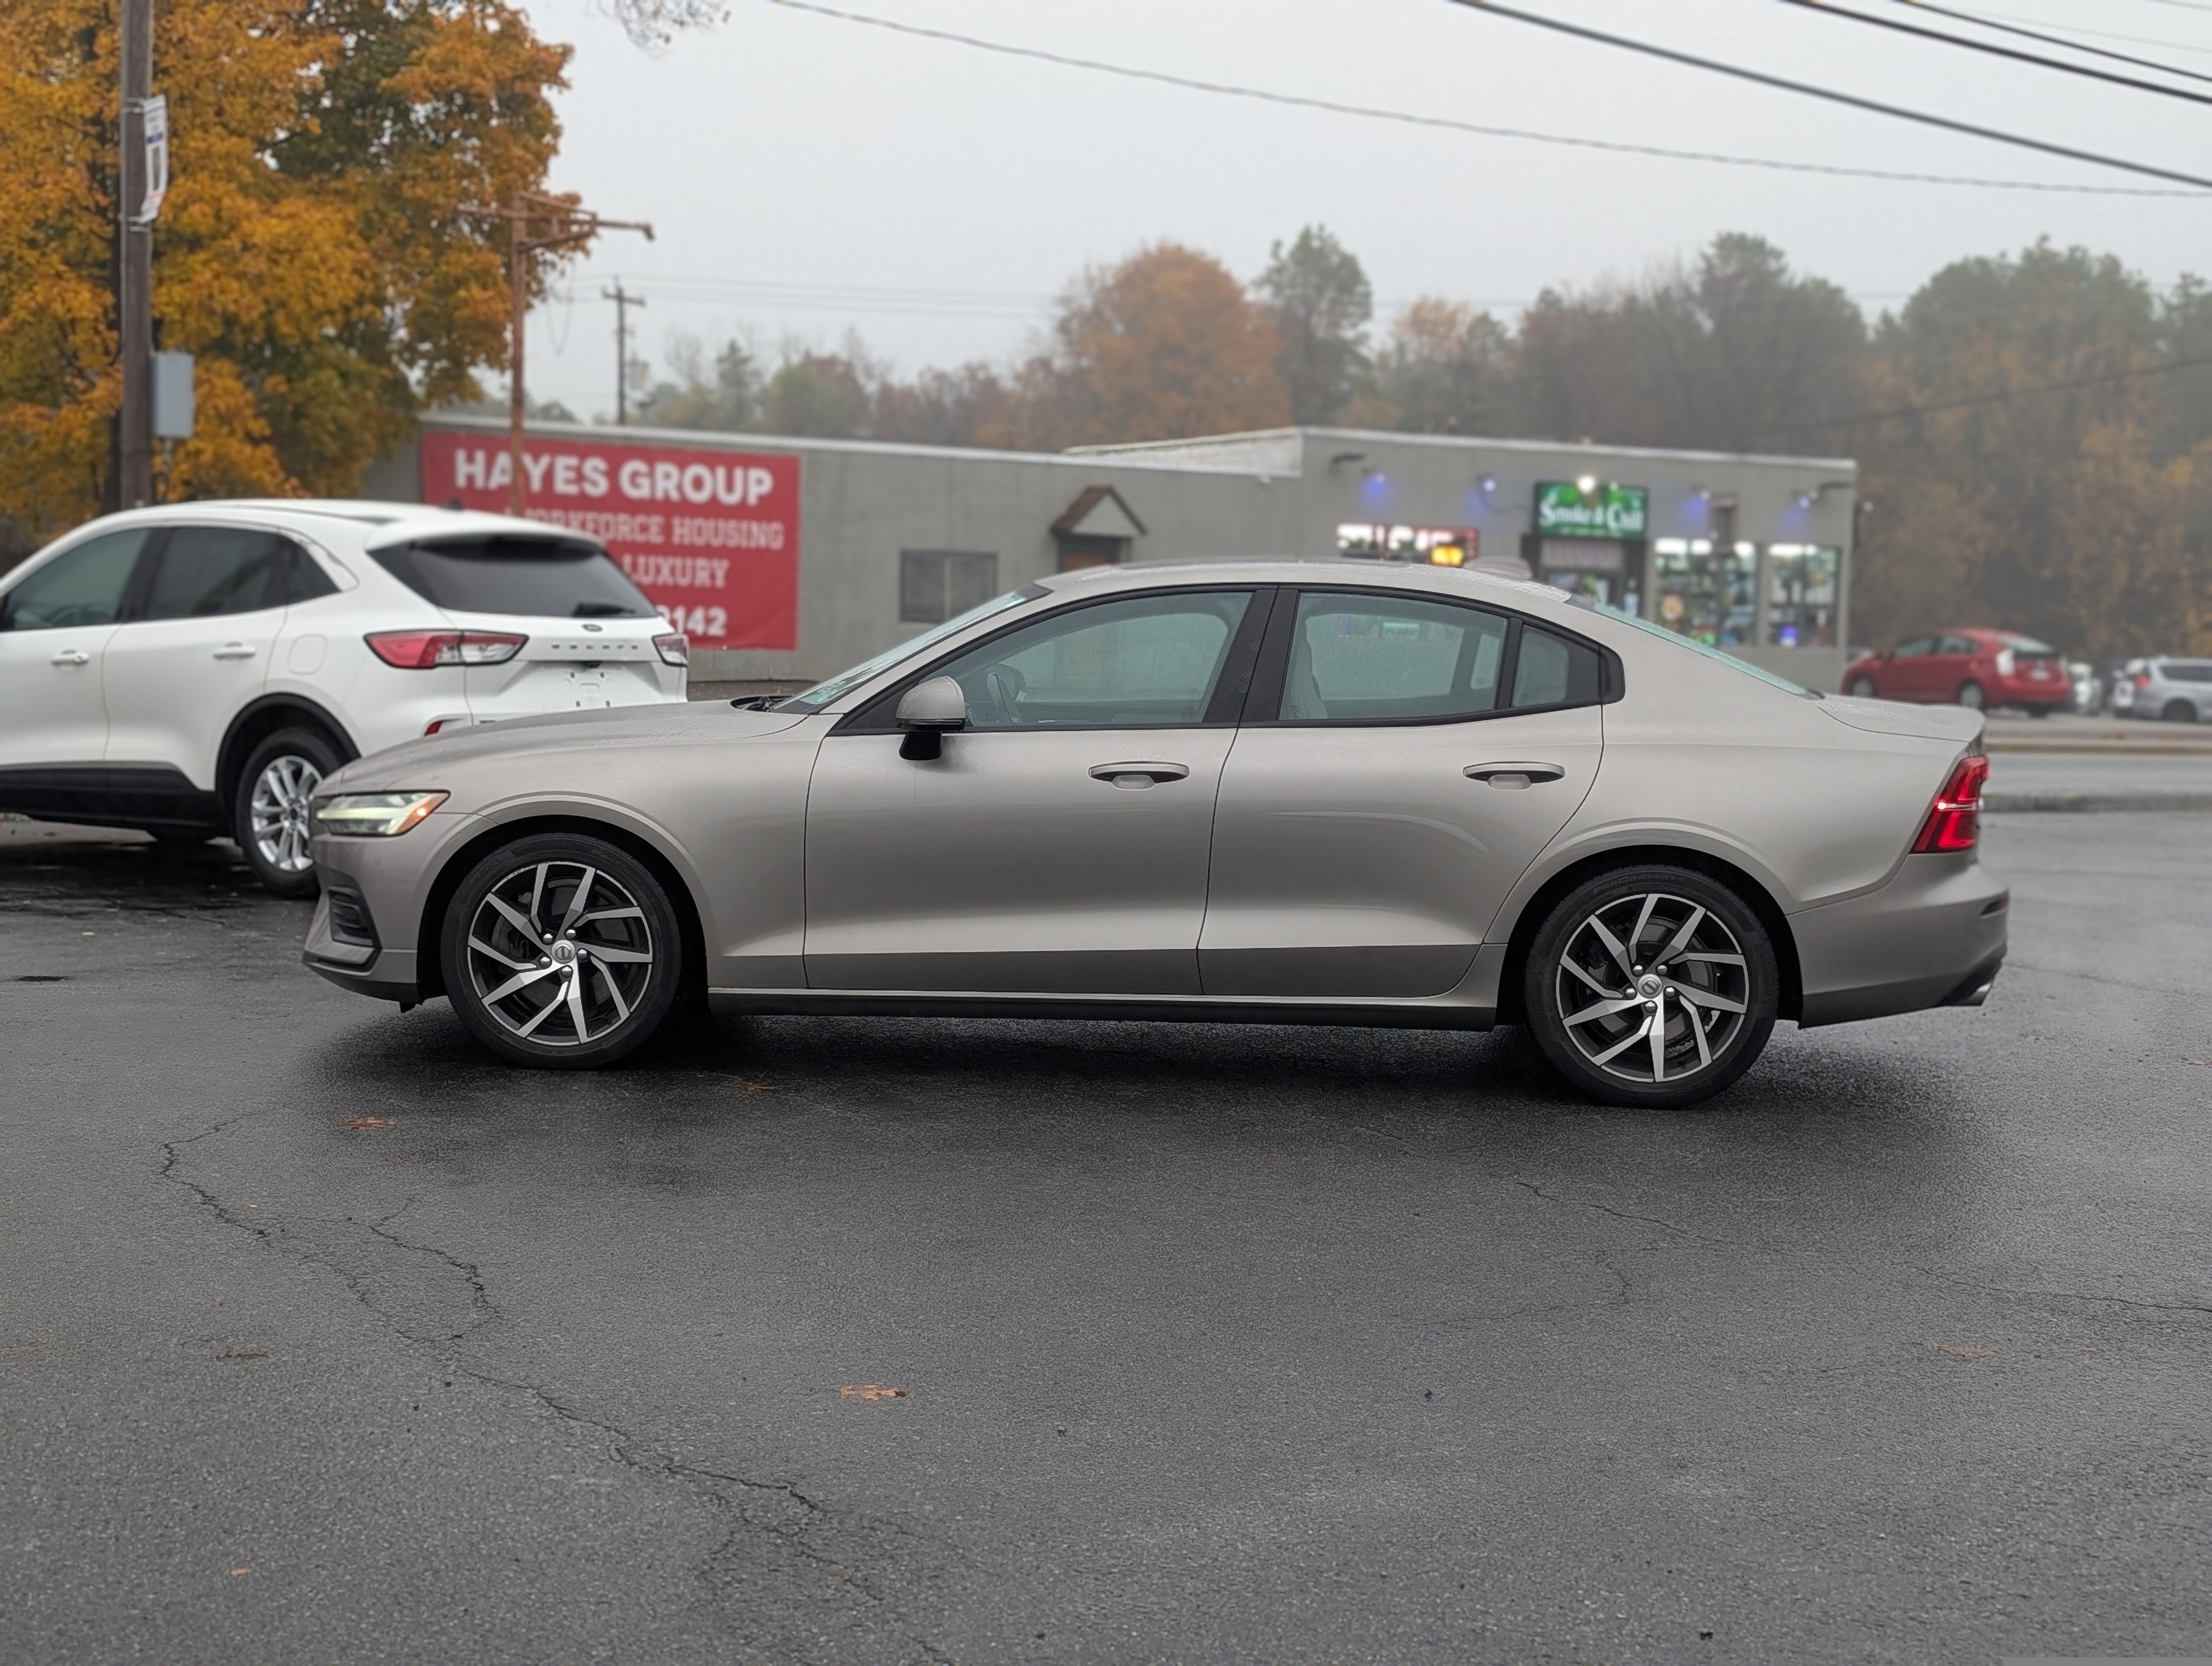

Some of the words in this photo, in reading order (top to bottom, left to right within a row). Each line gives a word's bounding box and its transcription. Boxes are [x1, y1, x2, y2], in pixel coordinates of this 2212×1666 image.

[455, 448, 609, 497] HAYES
[619, 459, 773, 505] GROUP
[672, 516, 784, 549] HOUSING
[622, 554, 729, 588] LUXURY
